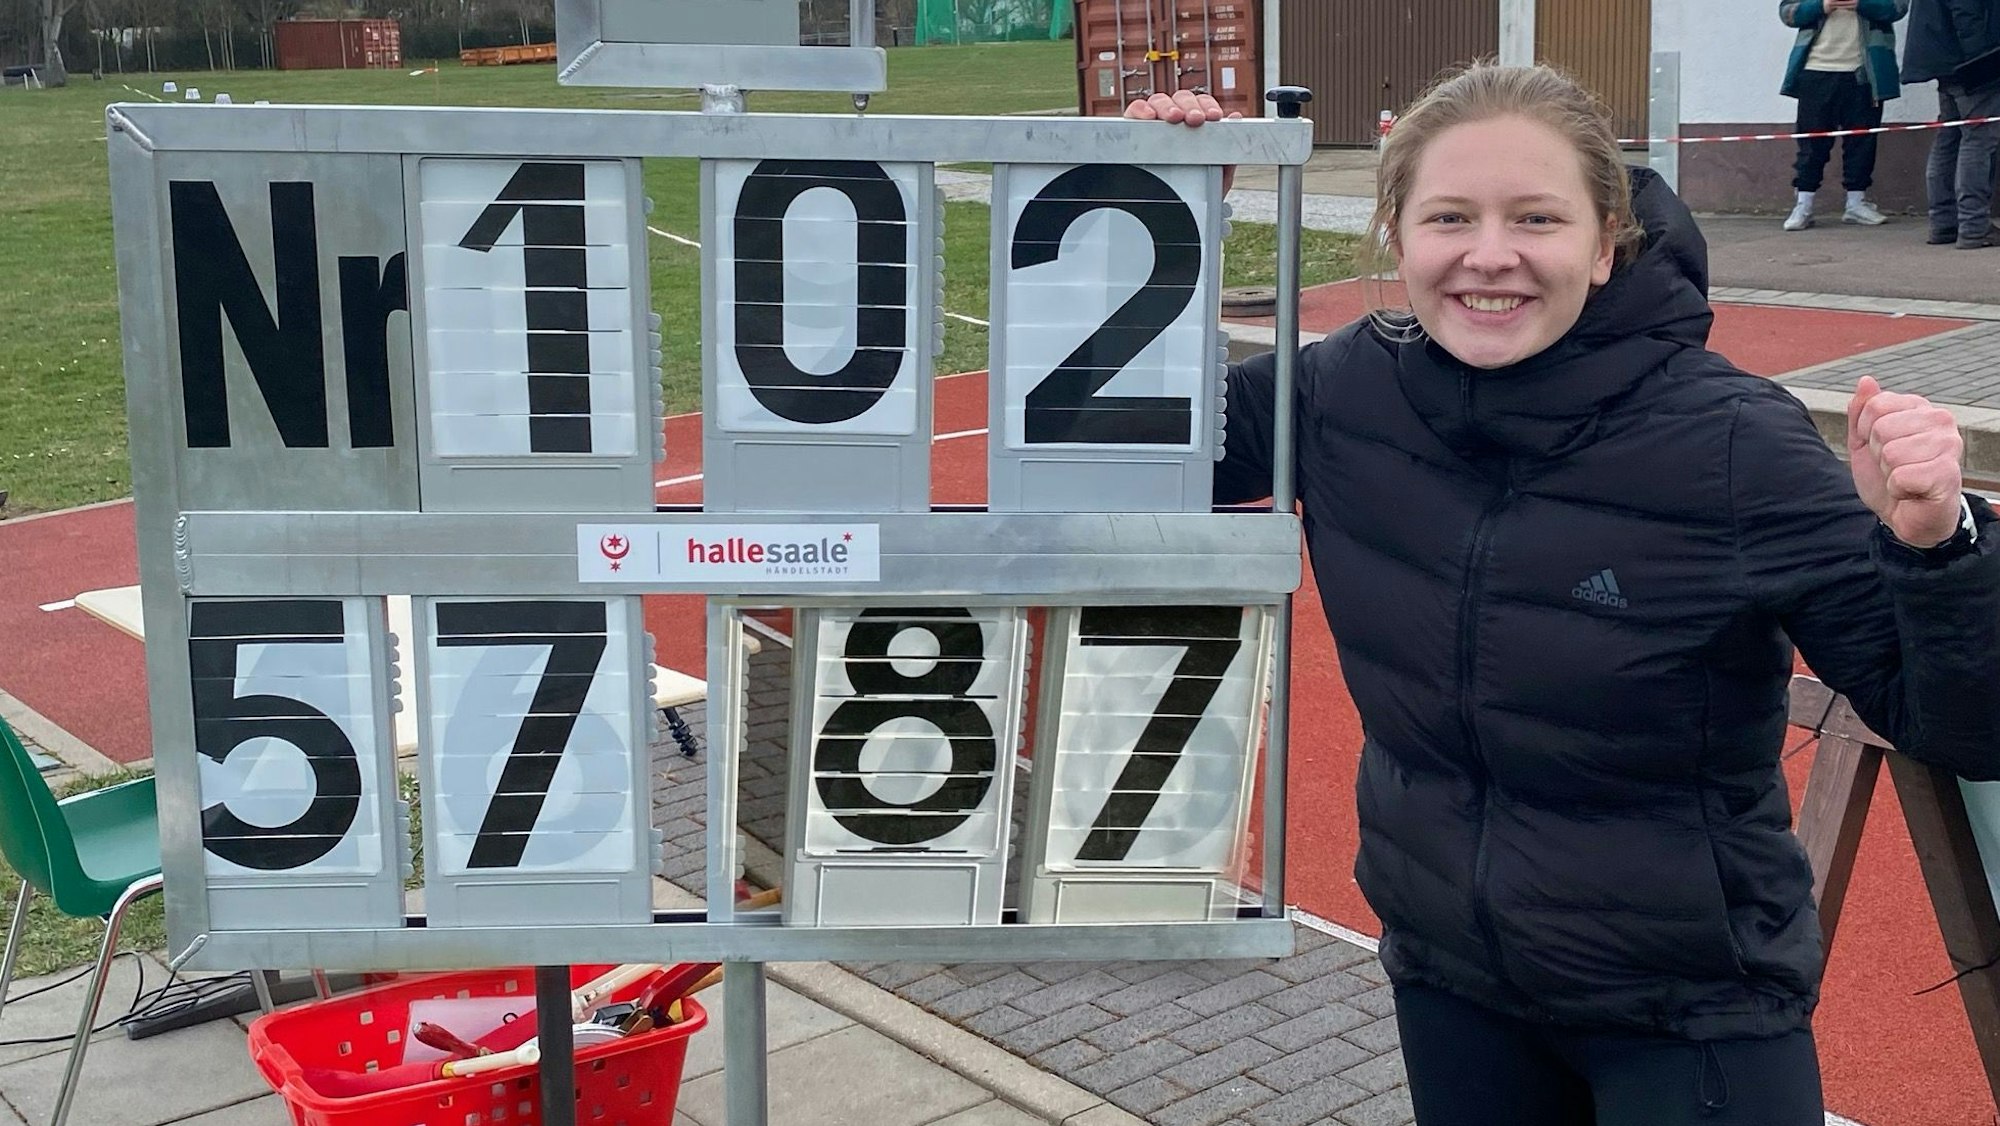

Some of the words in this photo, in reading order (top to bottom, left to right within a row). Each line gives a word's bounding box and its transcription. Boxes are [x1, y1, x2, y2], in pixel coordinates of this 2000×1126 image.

[170, 181, 408, 449] Nr
[688, 537, 849, 563] hallesaale
[766, 566, 849, 575] HÄNDELSTADT
[1571, 587, 1628, 608] adidas
